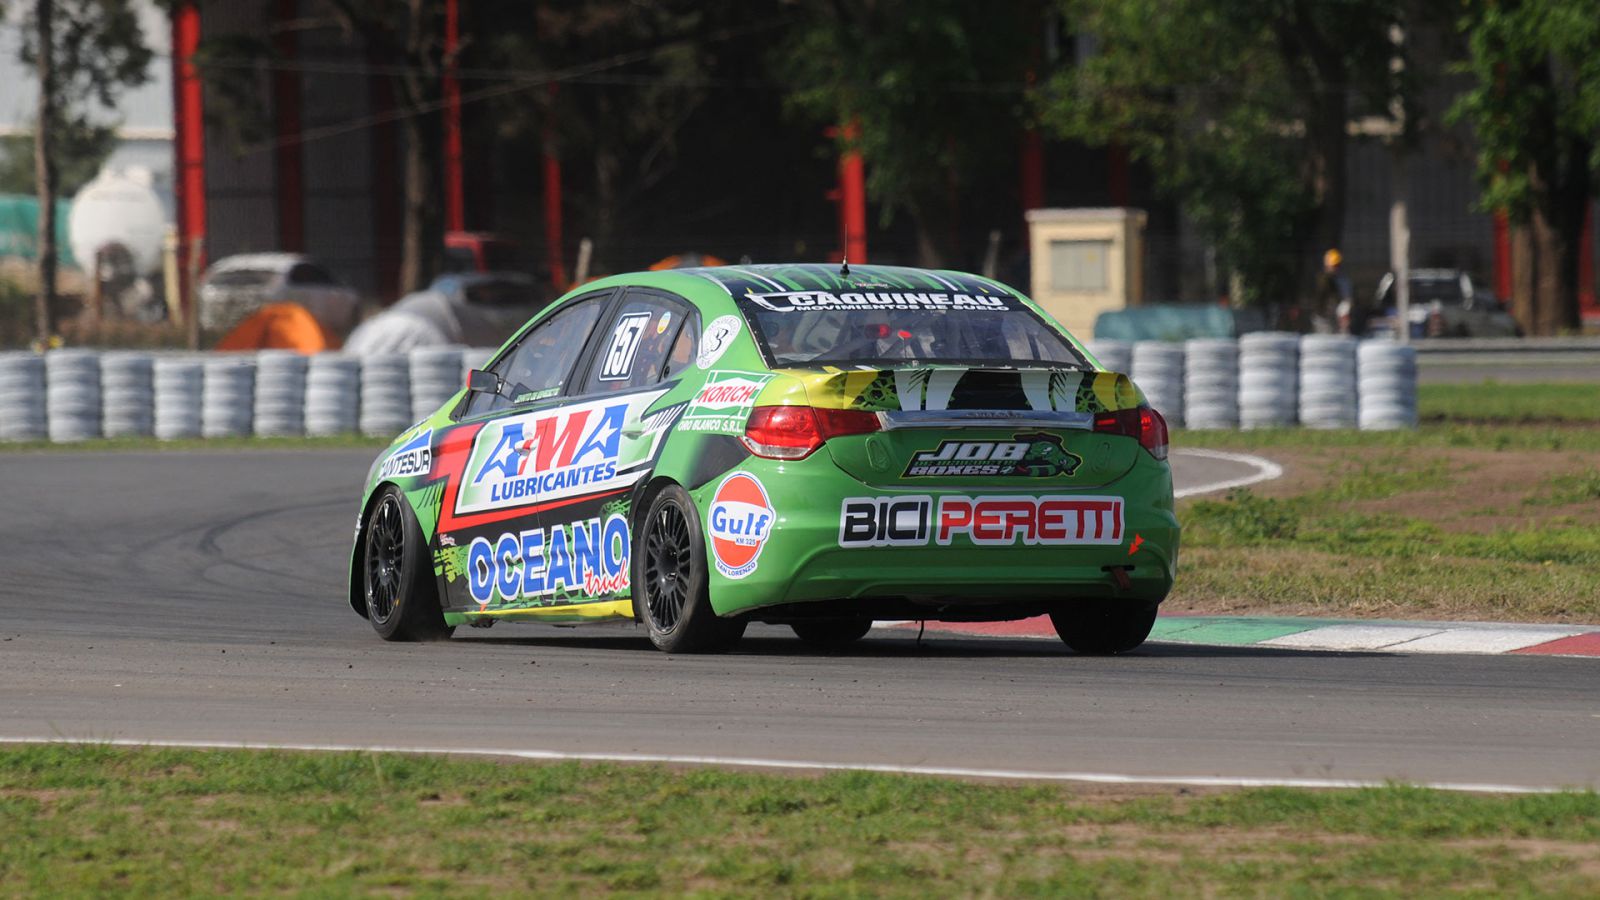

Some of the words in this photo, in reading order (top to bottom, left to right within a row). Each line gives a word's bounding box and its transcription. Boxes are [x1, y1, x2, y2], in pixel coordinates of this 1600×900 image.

[787, 292, 1004, 307] CAQUINEAU
[951, 304, 1010, 312] SUELO
[602, 316, 649, 376] 157
[697, 385, 758, 403] KORICH
[692, 419, 721, 431] BLANCO
[721, 420, 744, 433] S.R.L.
[474, 403, 629, 483] AMA
[917, 442, 1031, 462] JOB
[490, 461, 616, 502] LUBRICANTES
[908, 465, 1001, 476] BOXES
[712, 505, 770, 536] Gulf
[844, 501, 930, 542] BICI
[938, 500, 1122, 540] PERETTI
[469, 516, 630, 603] OCEANO
[716, 560, 727, 574] SAN
[728, 561, 756, 576] LORENZO
[584, 559, 629, 596] truck
